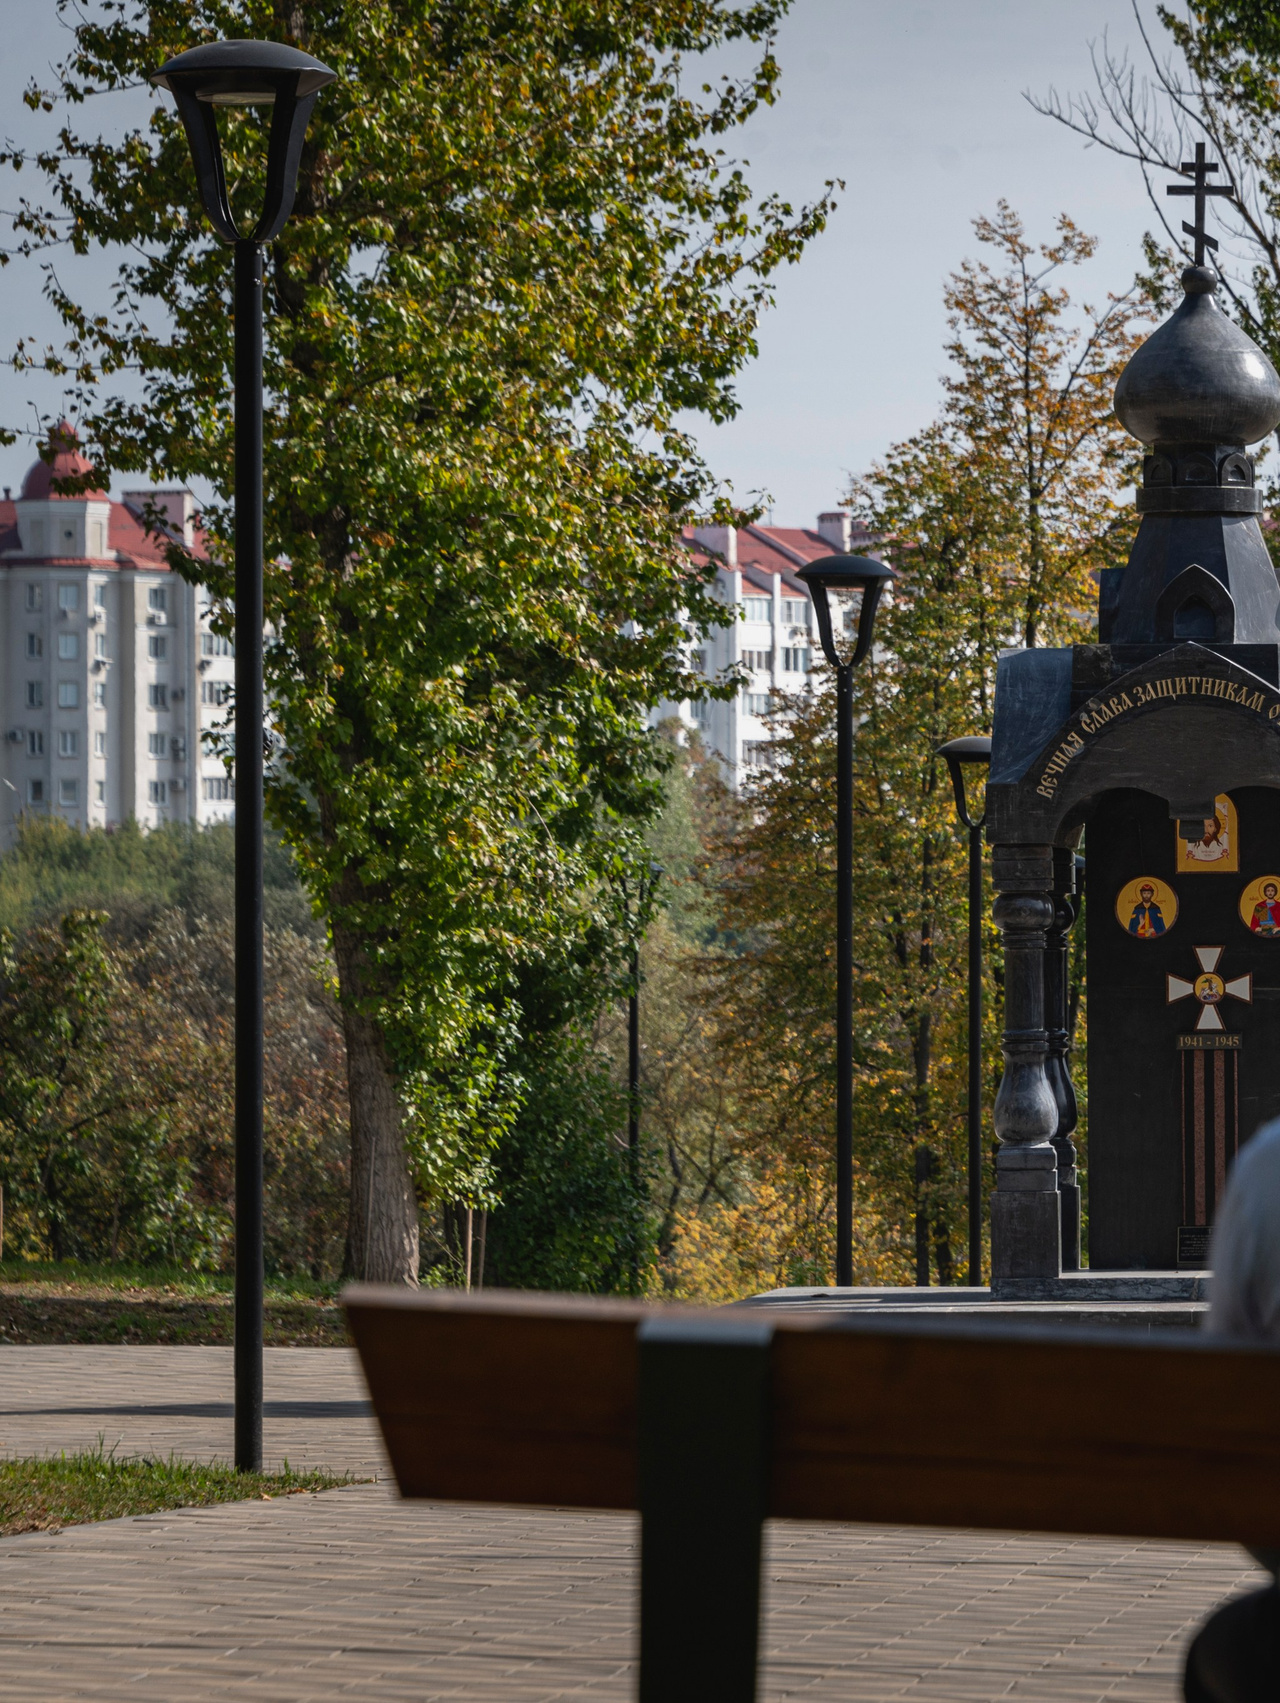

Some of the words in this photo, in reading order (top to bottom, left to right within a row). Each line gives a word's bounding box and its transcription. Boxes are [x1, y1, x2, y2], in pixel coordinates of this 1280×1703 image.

[1036, 731, 1085, 799] ВЕЧНАЯ
[1080, 691, 1134, 734] СЛАВА
[1133, 676, 1266, 713] ЗАЩИТНИКАМ
[1179, 1036, 1203, 1047] 1941
[1215, 1036, 1240, 1047] 1945
